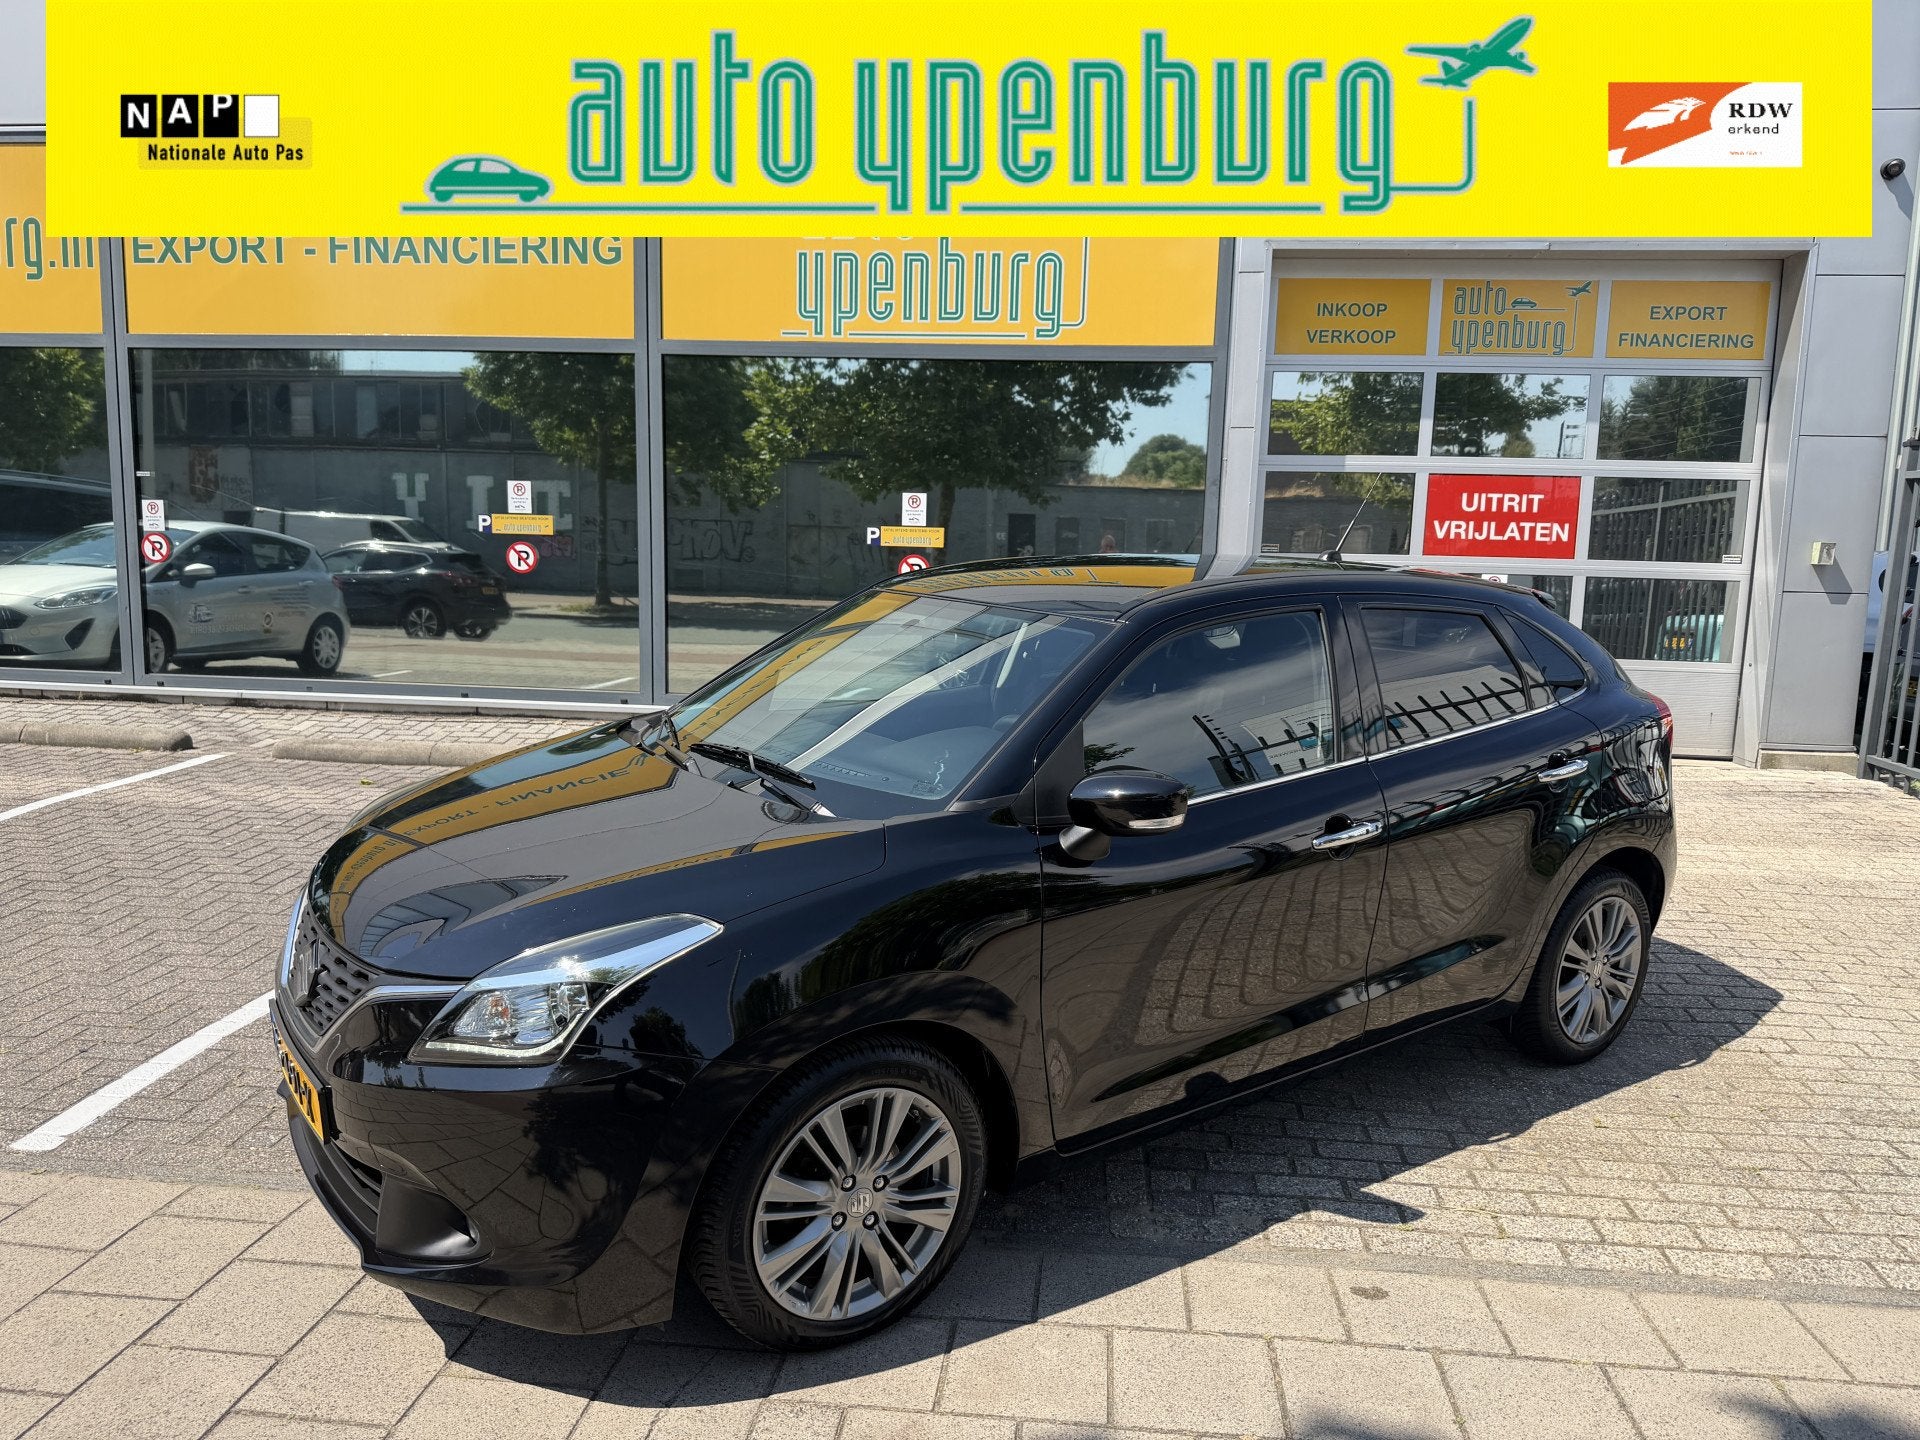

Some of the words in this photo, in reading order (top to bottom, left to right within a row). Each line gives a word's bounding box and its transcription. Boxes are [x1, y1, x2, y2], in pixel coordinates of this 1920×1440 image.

[132, 237, 285, 264] EXPORT
[329, 237, 623, 265] FINANCIERING
[796, 237, 1065, 340] ypenburg
[1454, 280, 1507, 315] auto
[1316, 302, 1388, 317] INKOOP
[1650, 305, 1728, 321] EXPORT
[1306, 329, 1397, 344] VERKOOP
[1452, 314, 1566, 355] ypenburg
[1618, 332, 1755, 349] FINANCIERING
[1461, 492, 1545, 513] UITRIT
[1433, 520, 1570, 542] VRIJLATEN
